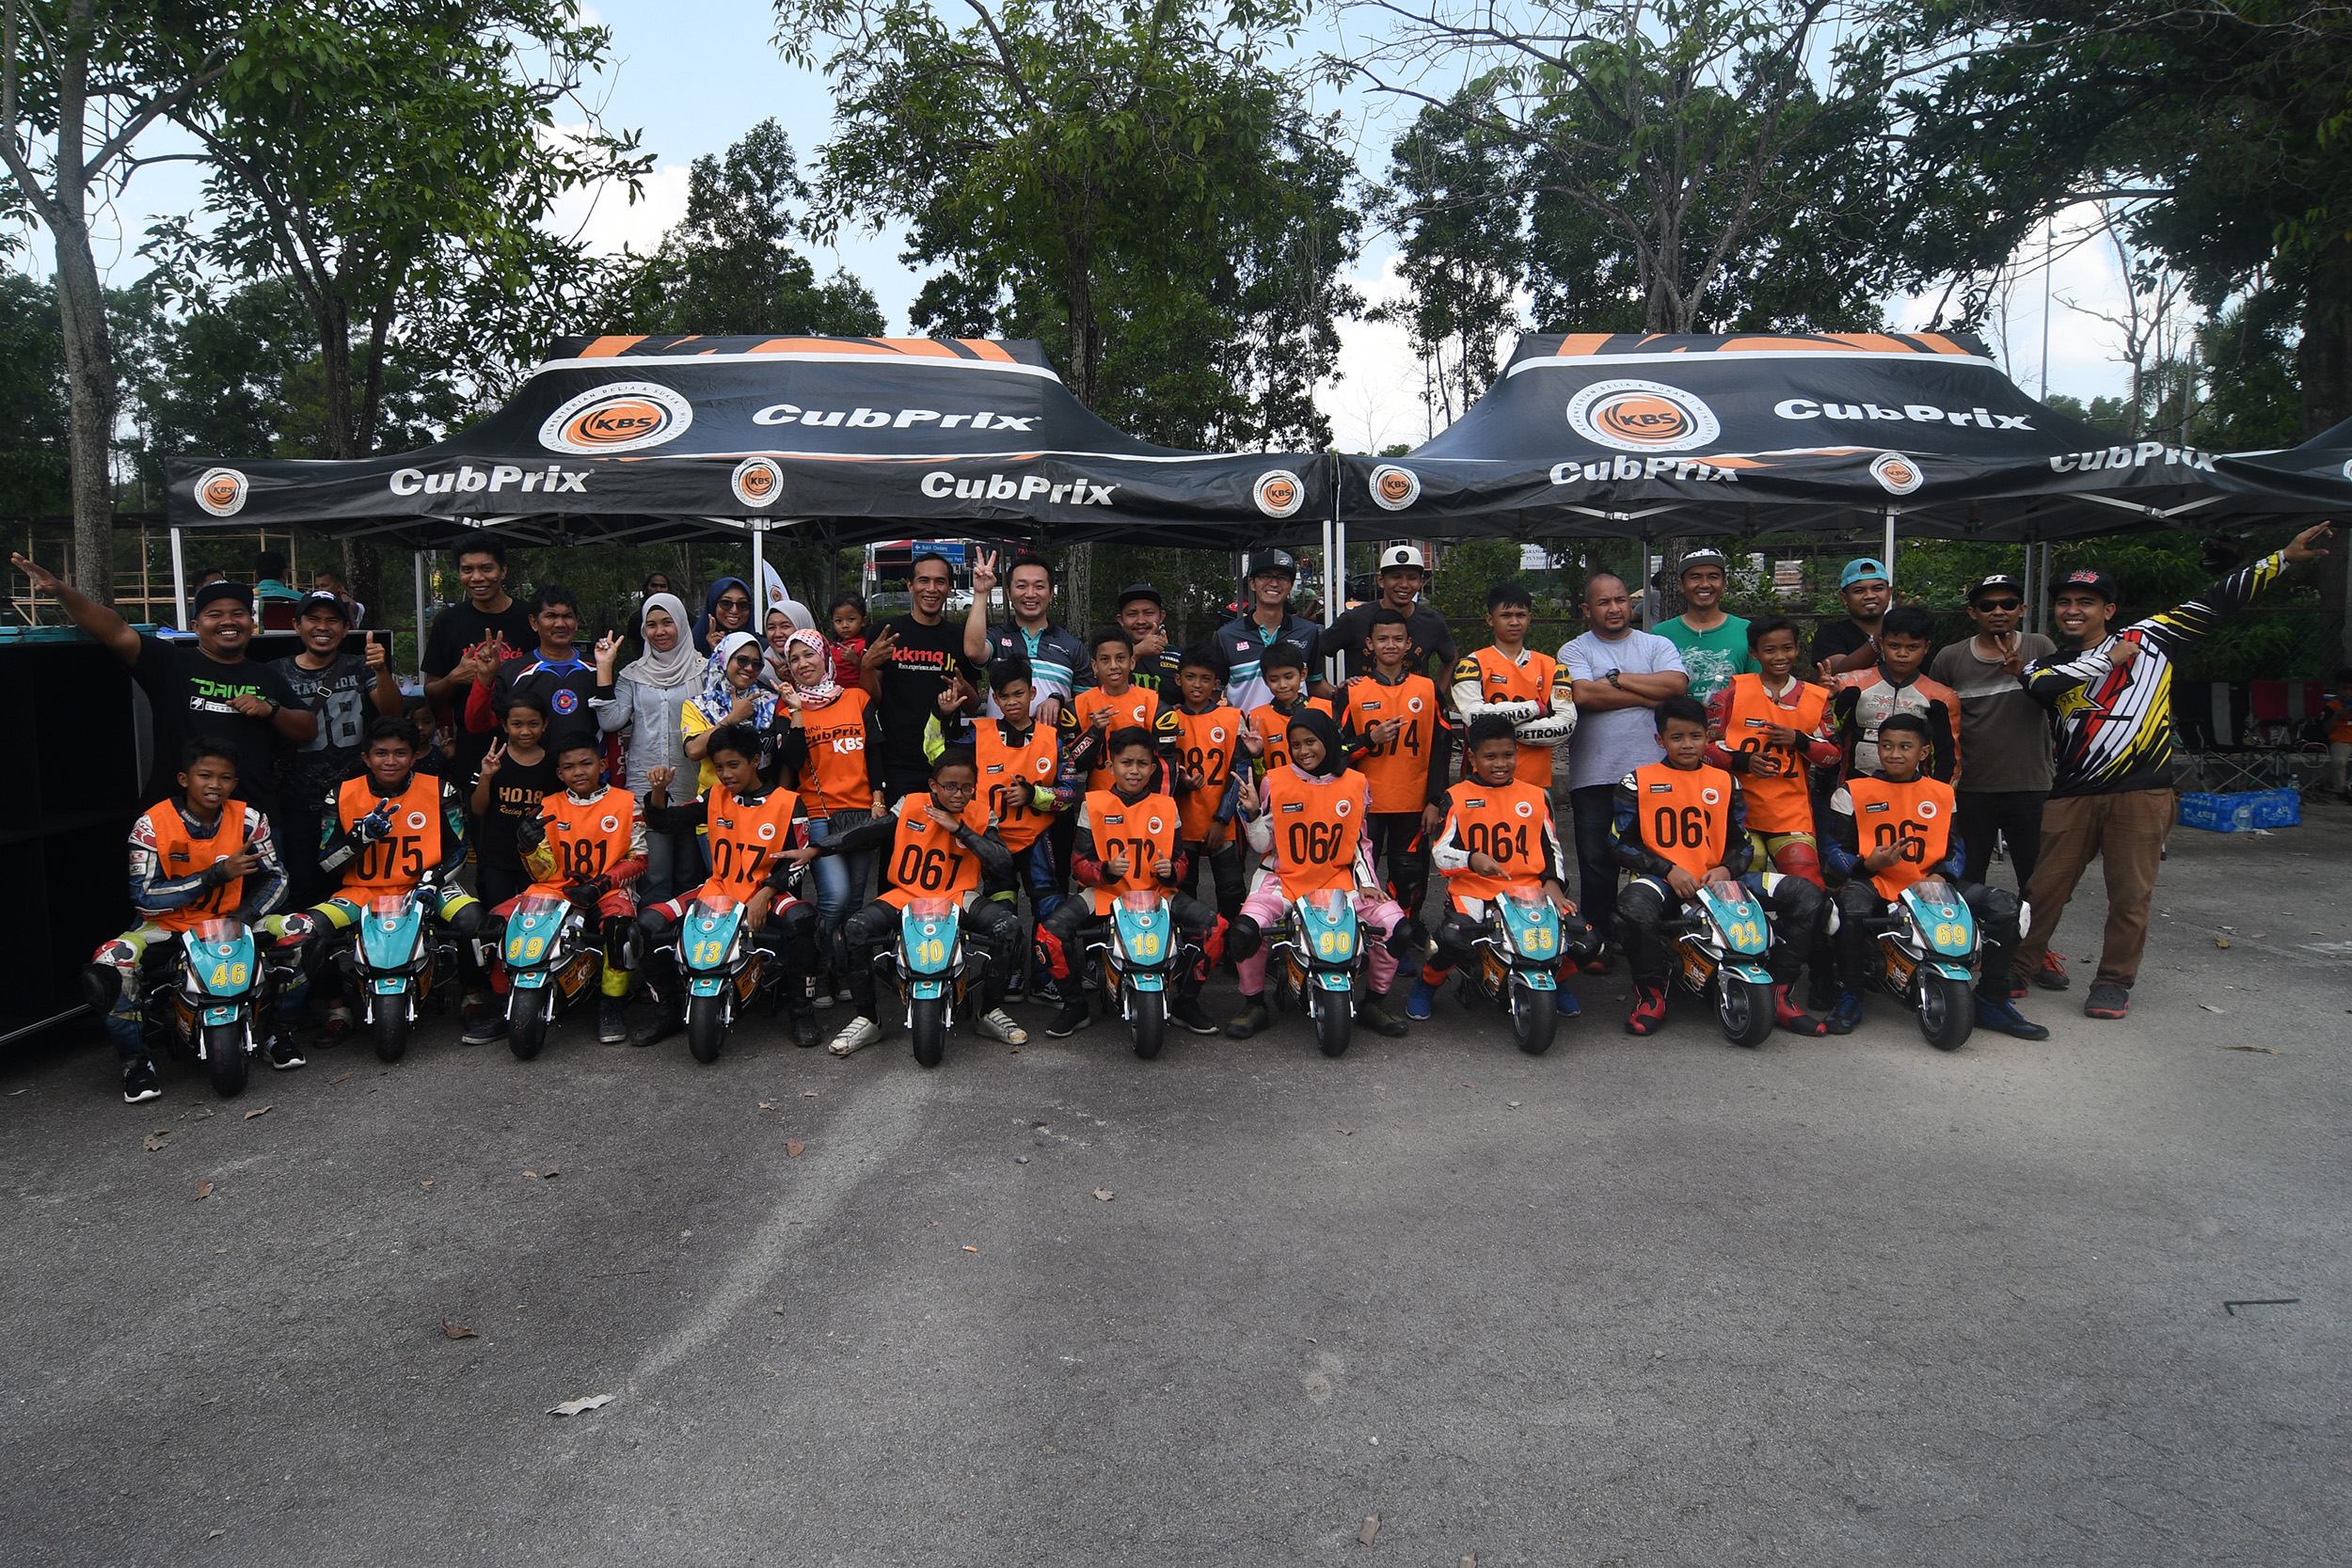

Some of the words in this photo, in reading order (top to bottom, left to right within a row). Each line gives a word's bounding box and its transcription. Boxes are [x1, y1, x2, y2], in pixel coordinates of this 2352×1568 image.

[596, 417, 654, 432] KBS
[752, 403, 1035, 432] CubPrix
[1619, 412, 1677, 427] KBS
[1774, 398, 2036, 431] CubPrix
[389, 465, 588, 497] CubPrix
[750, 476, 771, 486] KBS
[1549, 455, 1740, 485] CubPrix
[213, 485, 232, 496] KBS
[921, 471, 1117, 506] CubPrix
[1271, 488, 1292, 499] KBS
[1387, 480, 1407, 490] KBS
[190, 676, 262, 700] DRIVE
[1514, 724, 1573, 741] PETRONAS
[833, 736, 864, 754] KBS
[499, 804, 523, 816] Racing
[1468, 821, 1530, 865] 064
[357, 835, 423, 881] 075
[1131, 932, 1159, 958] 19
[1318, 931, 1352, 955] 90
[1521, 927, 1553, 952] 55
[1728, 922, 1763, 949] 22
[1933, 924, 1967, 947] 69
[507, 937, 545, 960] 99
[691, 940, 723, 964] 13
[915, 939, 945, 965] 10
[209, 962, 247, 988] 46
